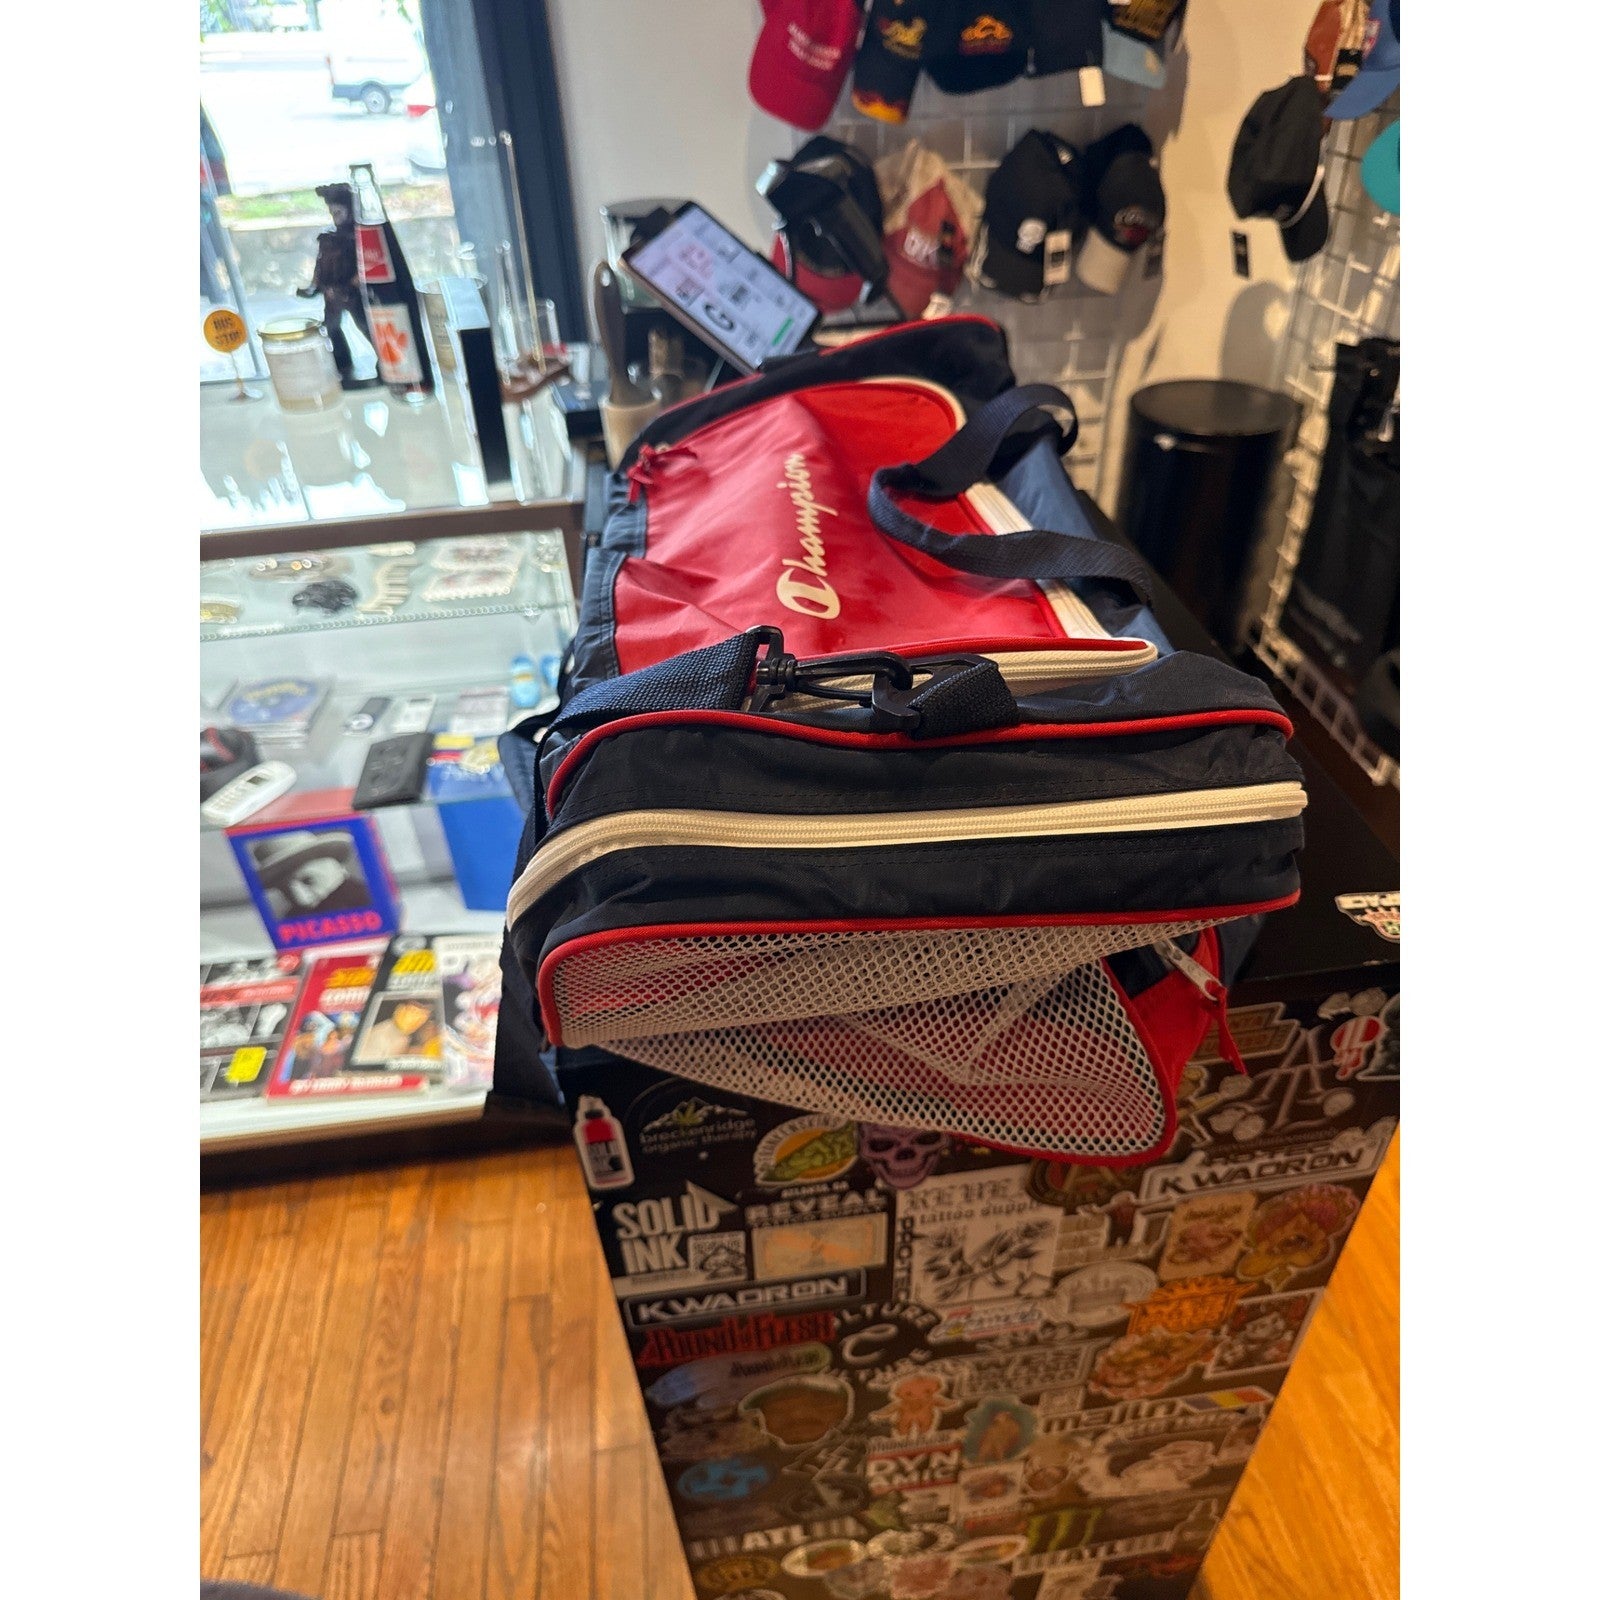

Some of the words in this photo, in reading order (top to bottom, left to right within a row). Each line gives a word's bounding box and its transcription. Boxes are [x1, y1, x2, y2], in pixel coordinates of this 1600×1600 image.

[776, 452, 841, 620] Champion
[277, 910, 383, 943] PICASSO
[1159, 1149, 1363, 1195] KWADRON
[611, 1191, 722, 1240] SOLID
[744, 1187, 888, 1218] REVEAL
[620, 1231, 691, 1276] INK
[637, 1276, 847, 1324] KWADRON
[865, 1448, 961, 1480] DYN
